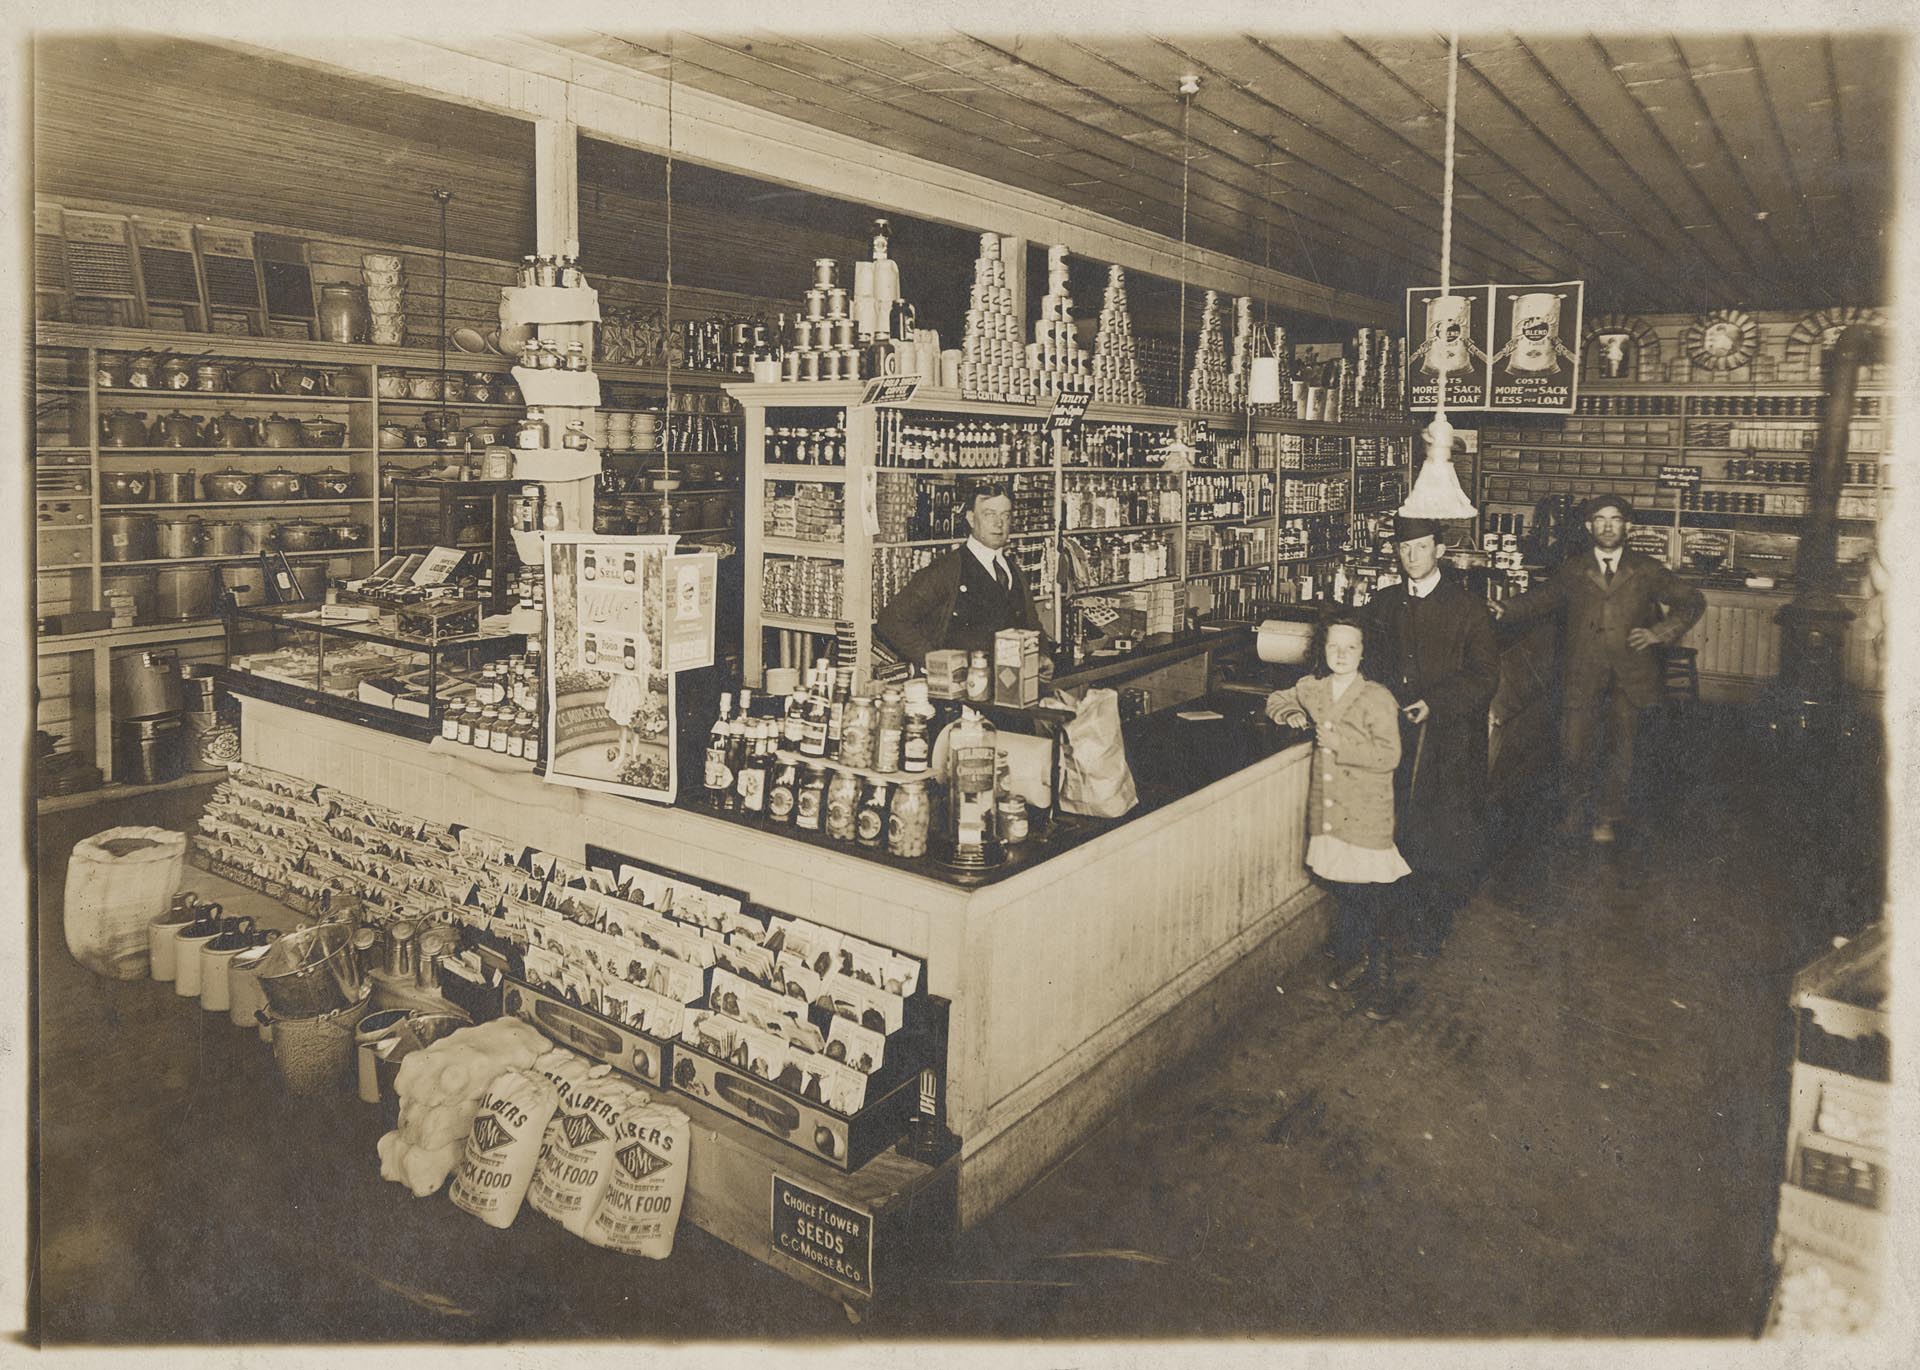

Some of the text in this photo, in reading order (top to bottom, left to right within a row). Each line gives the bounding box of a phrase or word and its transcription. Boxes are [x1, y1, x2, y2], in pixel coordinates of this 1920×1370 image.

[1412, 386, 1439, 394] MORE
[1453, 385, 1482, 394] SACK
[1495, 386, 1524, 394] MORE
[1536, 386, 1568, 394] SACK
[978, 391, 1005, 402] CENTRAL
[1059, 394, 1089, 404] TETLEY'S
[1413, 395, 1438, 404] LESS
[1453, 395, 1481, 404] LOAF
[1495, 396, 1522, 404] LESS
[1537, 396, 1568, 404] LOAF
[1054, 418, 1073, 426] TEAS
[600, 568, 620, 580] SELL
[614, 1122, 674, 1152] ALBERS
[478, 1172, 512, 1188] FOOD
[563, 1168, 598, 1186] FOOD
[605, 1184, 672, 1214] CHICK FOOD
[783, 1190, 860, 1237] CHOICE FLOWER
[797, 1218, 844, 1254] SEEDS
